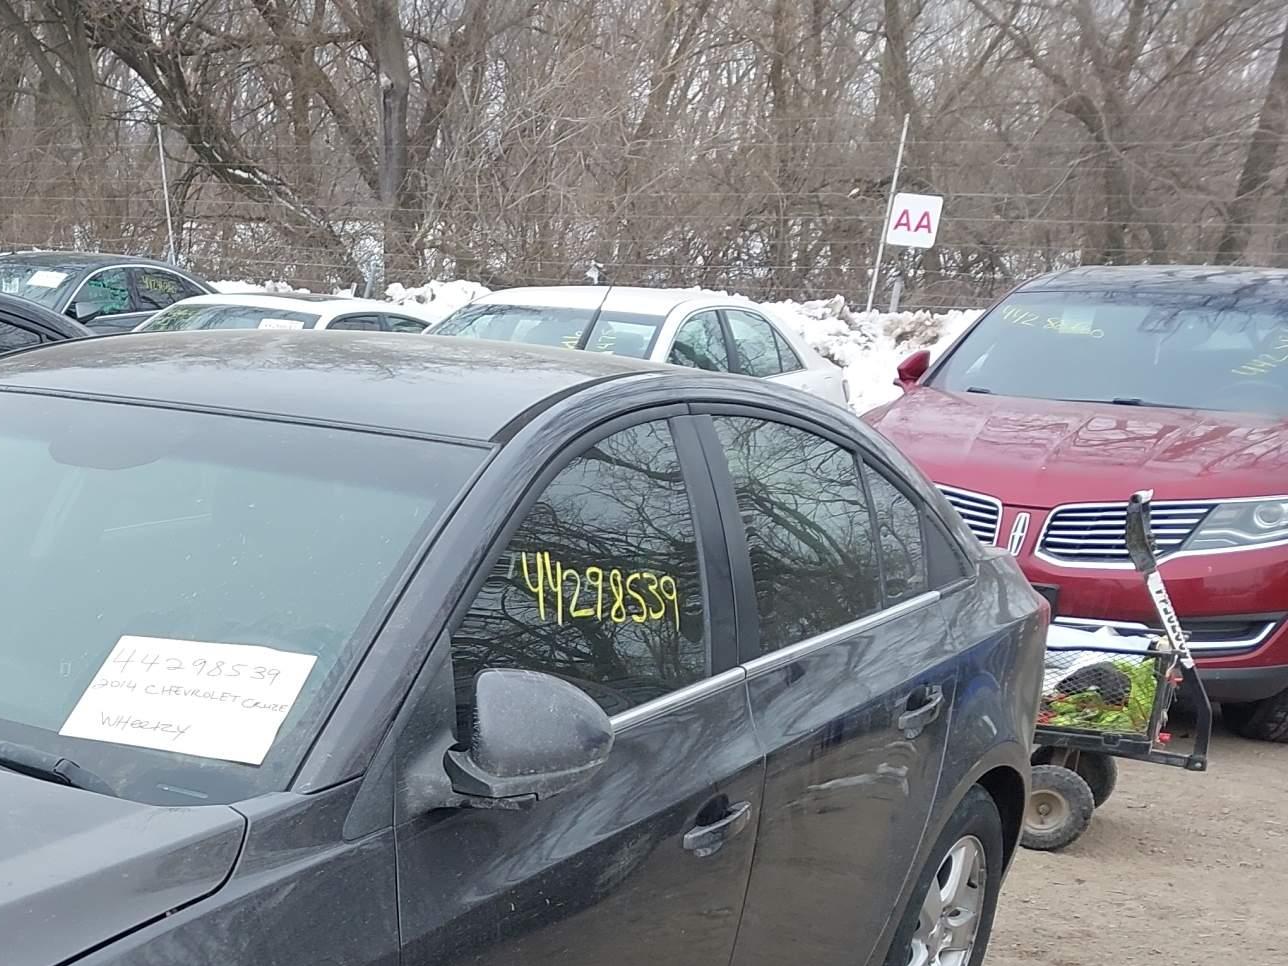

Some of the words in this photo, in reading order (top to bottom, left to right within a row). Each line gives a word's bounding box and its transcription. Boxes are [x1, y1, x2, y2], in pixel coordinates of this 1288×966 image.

[893, 208, 933, 234] AA
[520, 551, 681, 632] 44298539
[113, 647, 281, 686] 44298539
[93, 678, 137, 690] 2014
[144, 684, 241, 704] CHEVROLET
